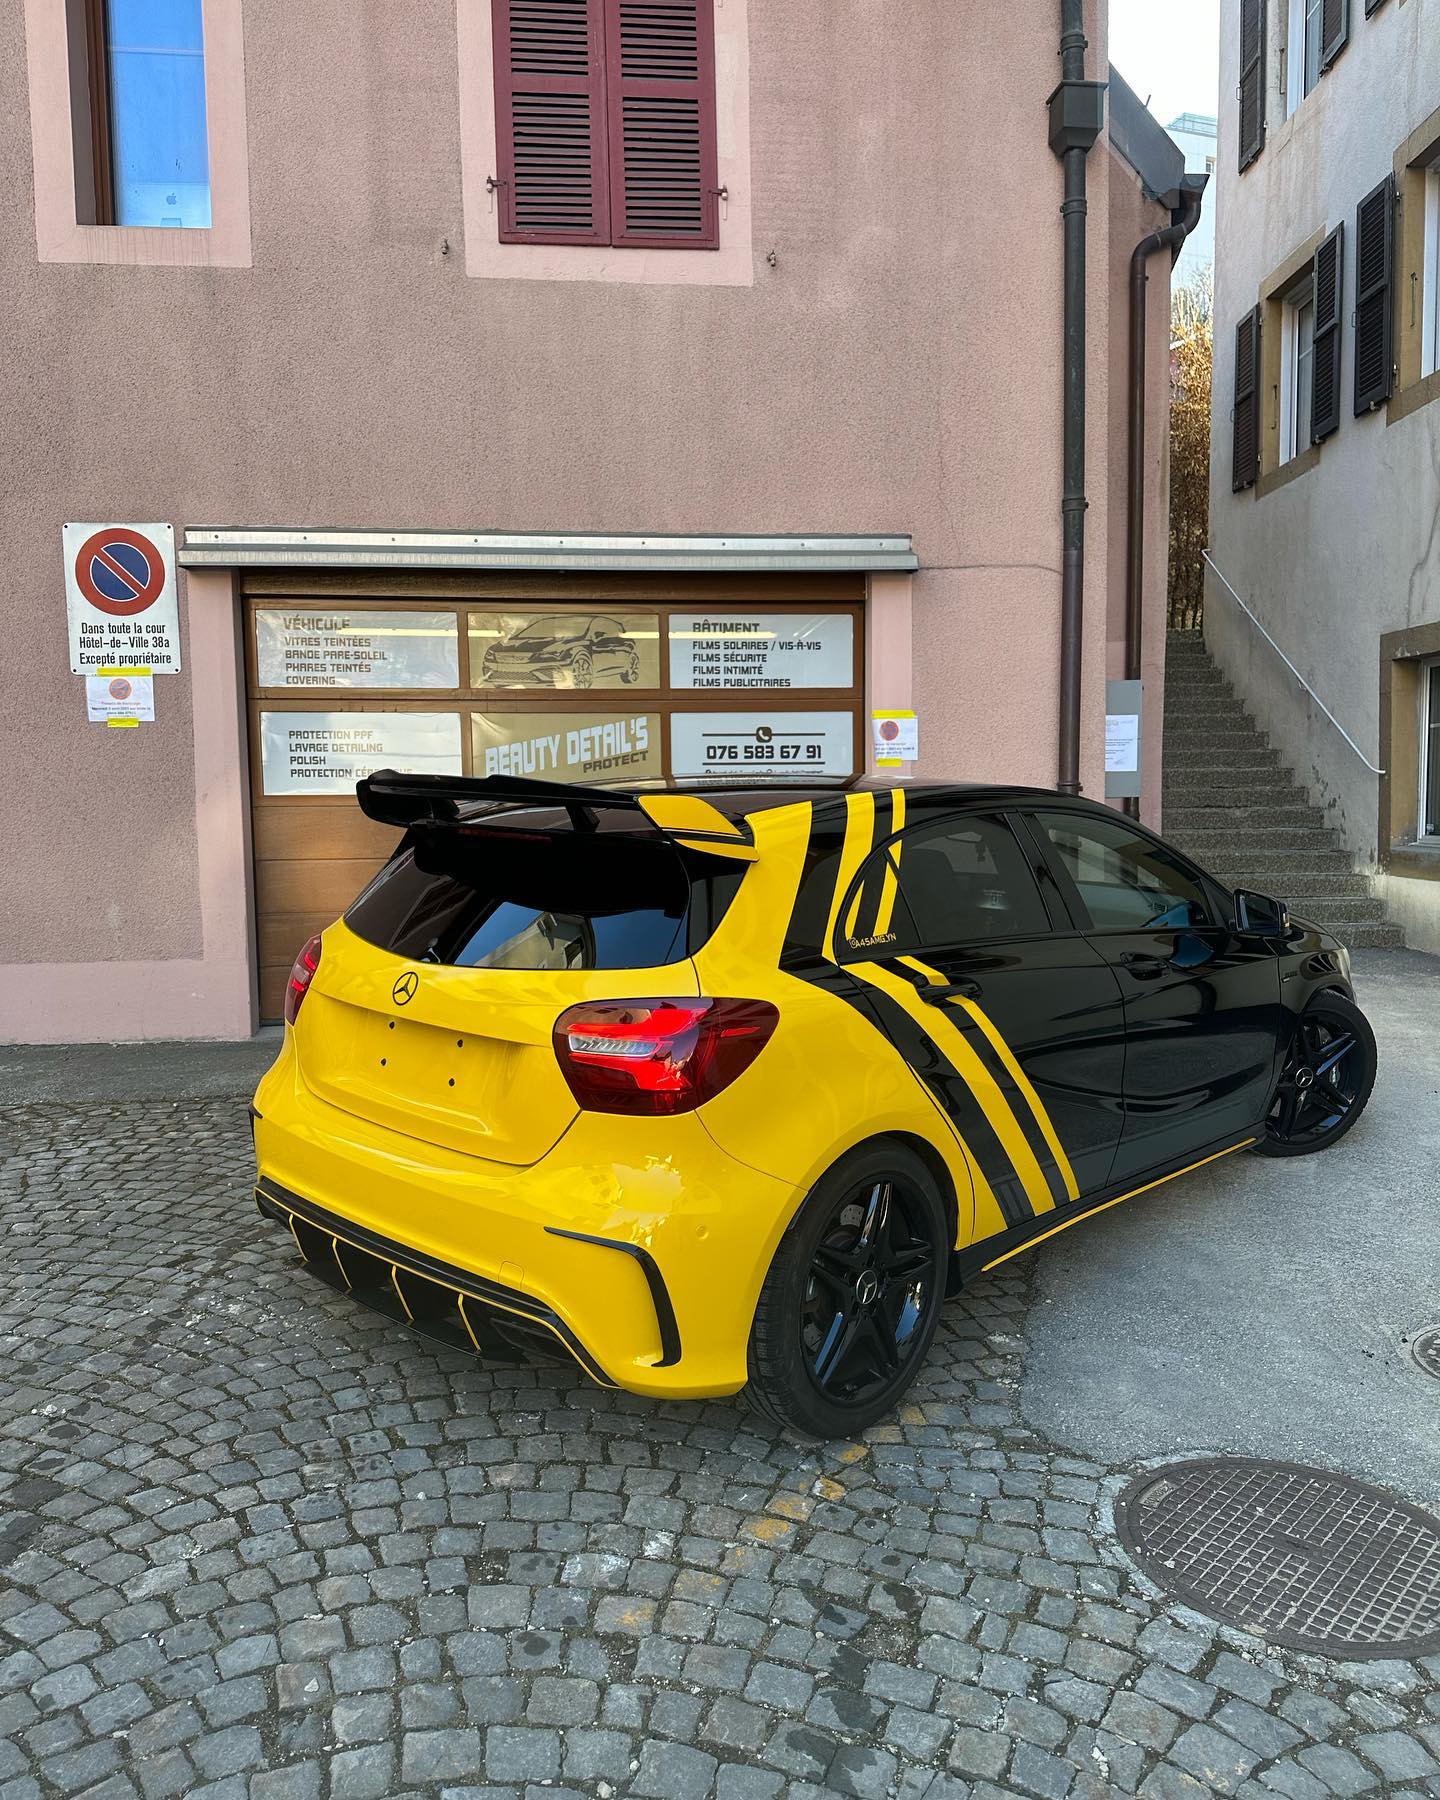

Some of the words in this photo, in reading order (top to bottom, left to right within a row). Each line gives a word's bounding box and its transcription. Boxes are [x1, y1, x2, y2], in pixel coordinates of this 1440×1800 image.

[81, 622, 105, 634] Dans
[108, 622, 131, 634] toute
[134, 622, 142, 634] la
[145, 624, 166, 634] cour
[283, 613, 351, 631] VÉHICULE
[692, 619, 760, 634] BÂTIMENT
[79, 636, 149, 649] Hôtel-de-Ville
[152, 636, 170, 648] 38a
[284, 636, 321, 647] VITRES
[324, 635, 371, 647] TEINTÉES
[692, 641, 721, 650] FILMS
[723, 641, 769, 651] SOLAIRES
[771, 641, 776, 651] /
[778, 639, 822, 651] VIS-À-VIS
[79, 652, 116, 667] Excepté
[119, 652, 172, 667] propriétaire
[285, 650, 320, 659] BANDE
[323, 650, 388, 660] PARE-SOLEIL
[692, 653, 721, 663] FILMS
[723, 651, 768, 663] SÉCURITE
[285, 663, 327, 672] PHARES
[330, 661, 371, 673] TEINTÉS
[692, 666, 721, 675] FILMS
[723, 664, 764, 675] INTIMITÉ
[286, 676, 336, 685] COVERING
[693, 678, 721, 688] FILMS
[723, 678, 791, 688] PUBLICITAIRES
[289, 730, 351, 740] PROTECTION
[354, 731, 374, 740] PPF
[289, 743, 329, 752] LAVAGE
[332, 743, 383, 752] DETAILING
[485, 734, 561, 778] BEAUTY
[566, 716, 649, 765] DETAIL'S
[706, 745, 739, 760] 076
[743, 745, 775, 760] 583
[780, 745, 803, 760] 67
[806, 745, 822, 760] 91
[290, 756, 326, 765] POLISH
[583, 750, 649, 773] PROTECT
[291, 768, 353, 778] PROTECTION
